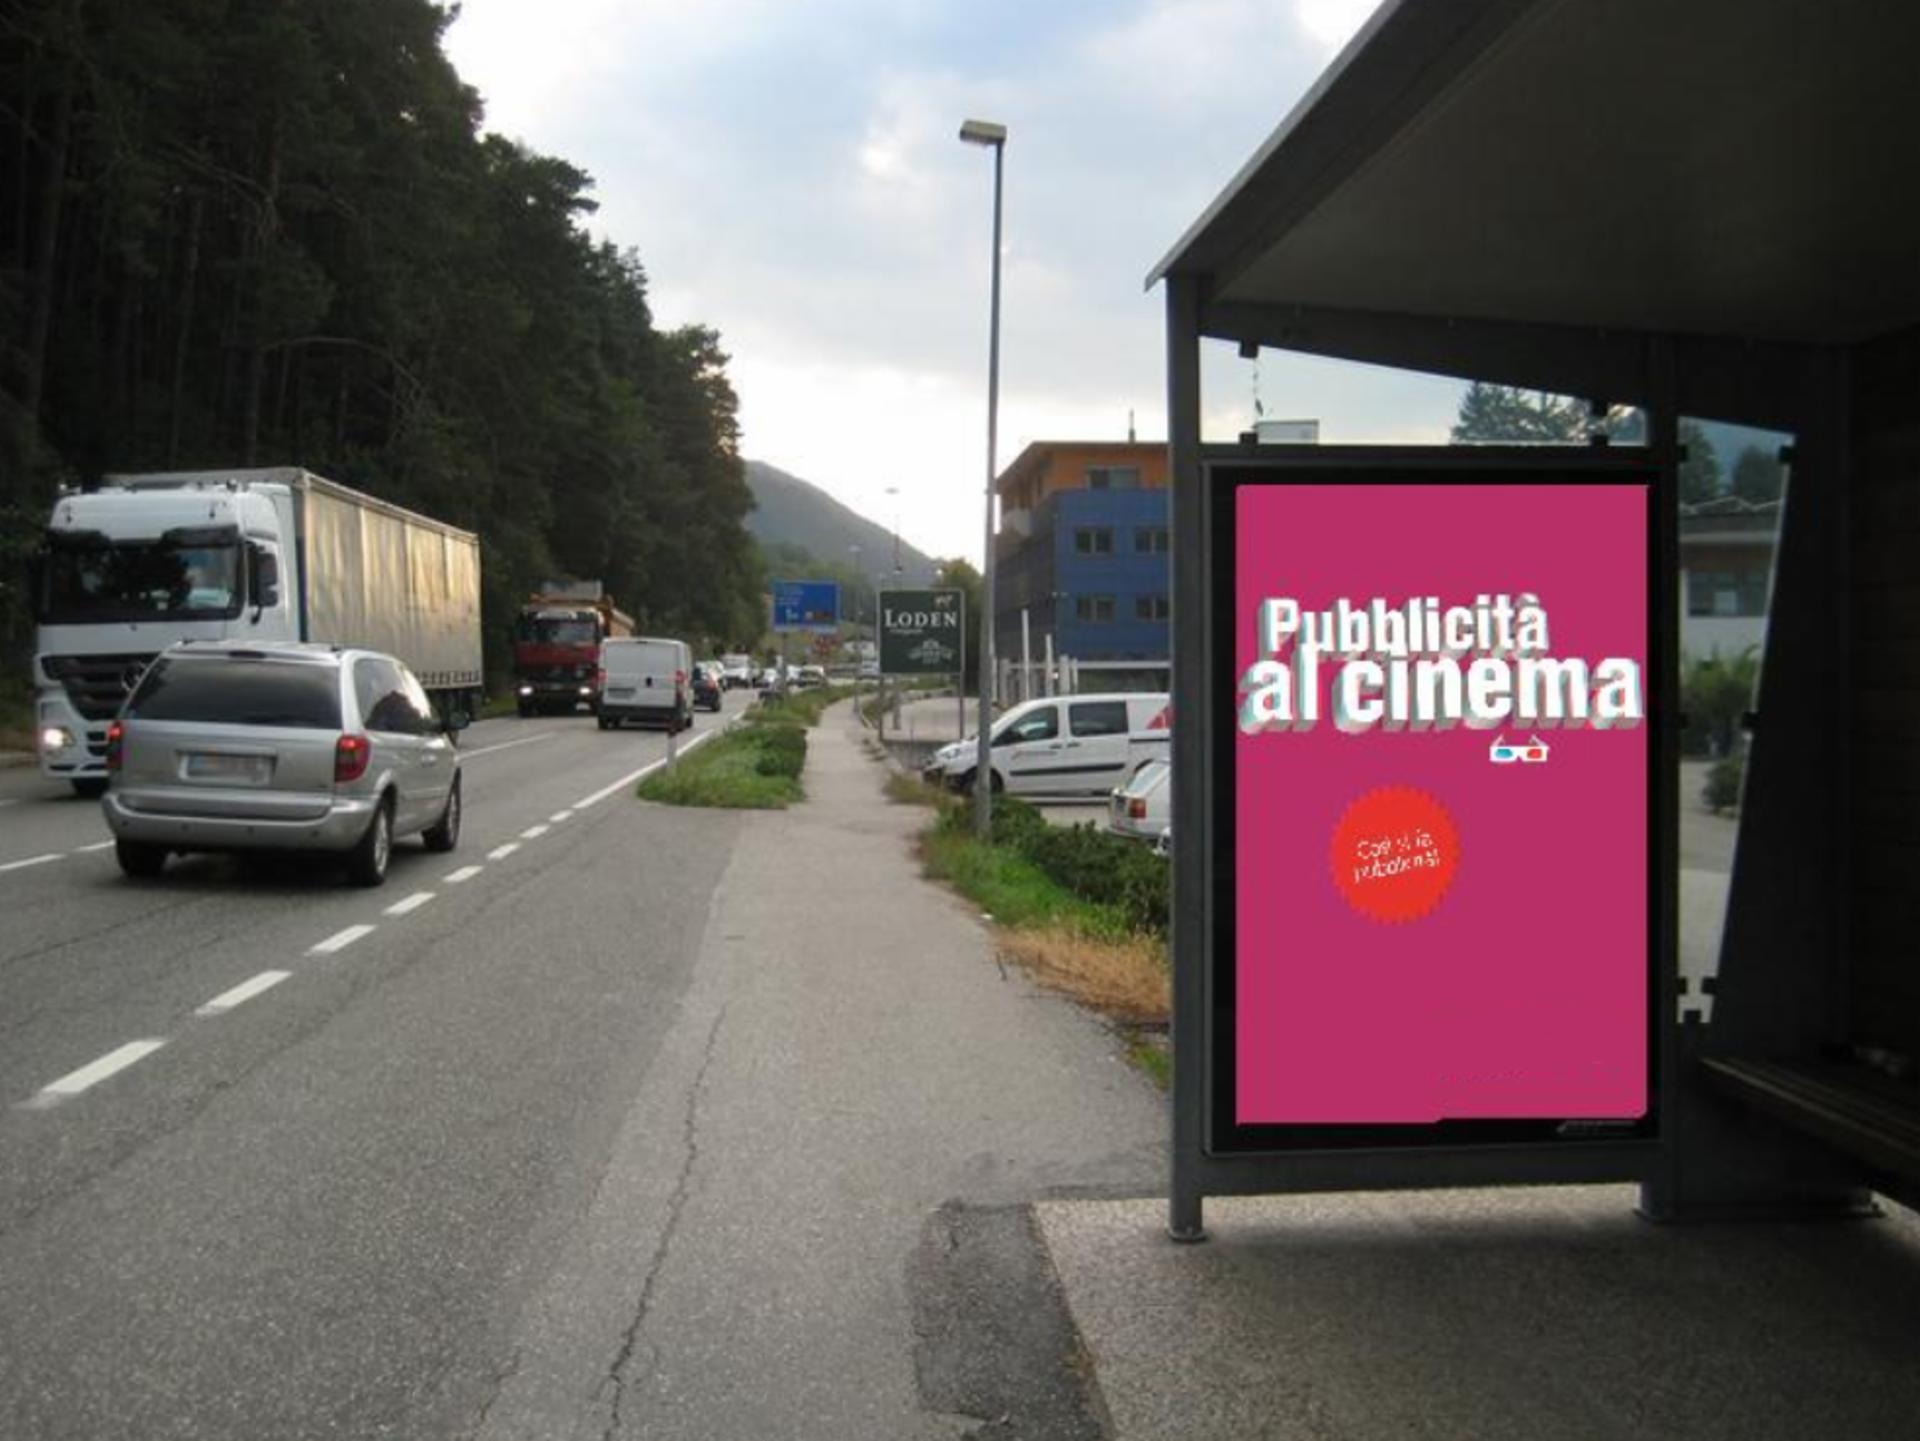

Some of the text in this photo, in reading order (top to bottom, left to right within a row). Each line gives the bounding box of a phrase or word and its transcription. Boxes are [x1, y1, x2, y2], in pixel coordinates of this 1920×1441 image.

[884, 609, 957, 628] LODEN
[1260, 593, 1549, 658] Pubblicità
[1241, 642, 1643, 731] al cinema
